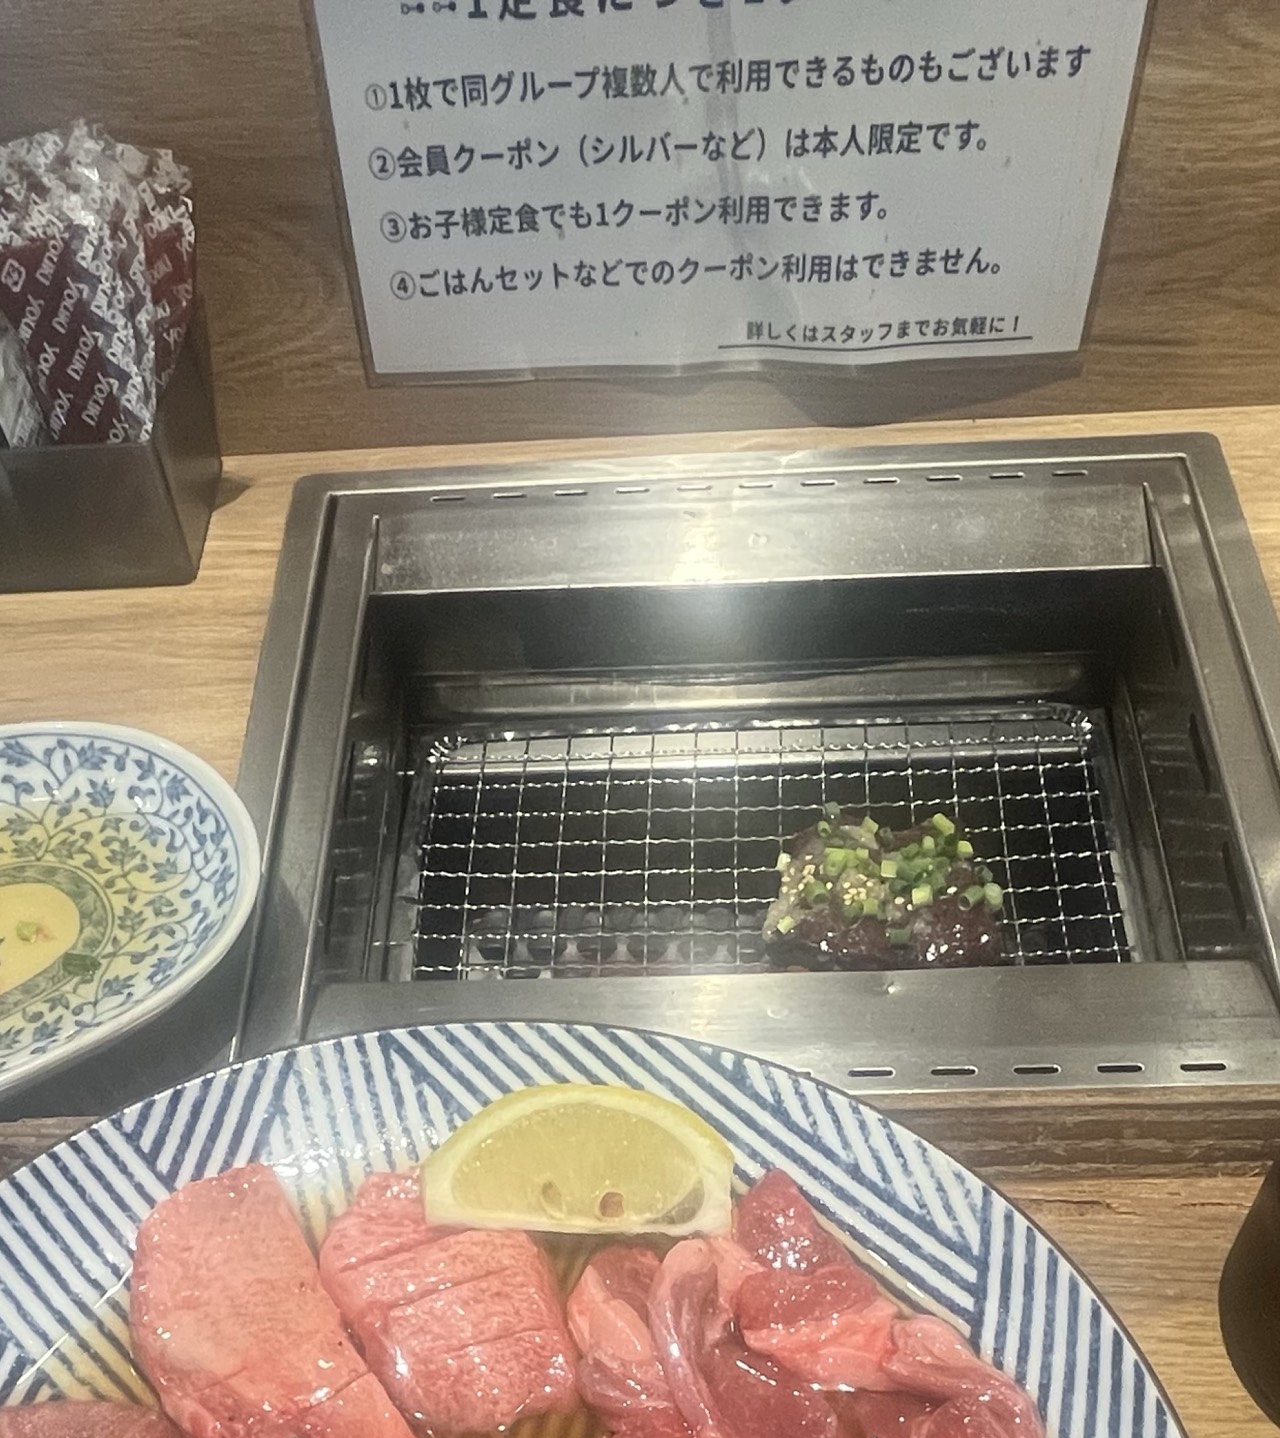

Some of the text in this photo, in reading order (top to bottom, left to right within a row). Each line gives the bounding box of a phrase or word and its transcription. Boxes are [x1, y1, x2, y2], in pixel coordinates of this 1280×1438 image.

[365, 44, 1091, 111] ①1枚で同グループ複数人で利用できるものもございます
[380, 191, 887, 243] ③お子様定食でも1クーポン利用できます。
[390, 247, 1001, 300] ④ごはんセットなどでのクーポン利用はできません。
